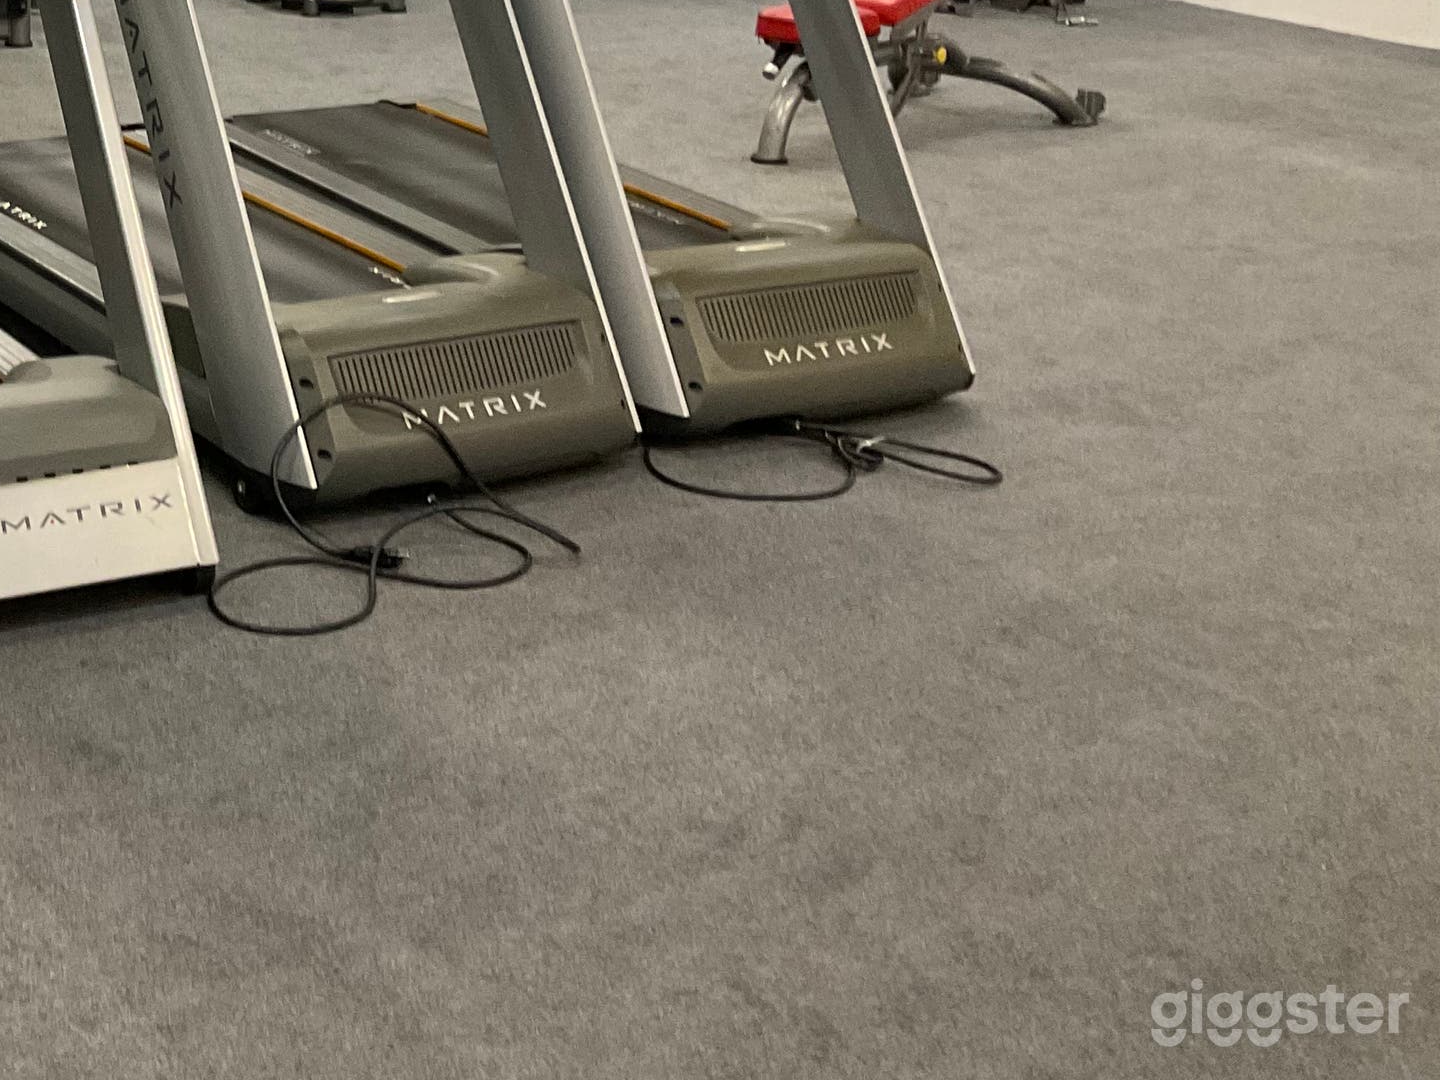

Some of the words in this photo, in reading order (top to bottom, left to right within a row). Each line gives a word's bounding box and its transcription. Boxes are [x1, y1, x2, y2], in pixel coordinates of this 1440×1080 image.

[763, 333, 893, 366] MATRIX
[401, 388, 547, 430] MATRIX
[0, 494, 172, 534] MATRIX
